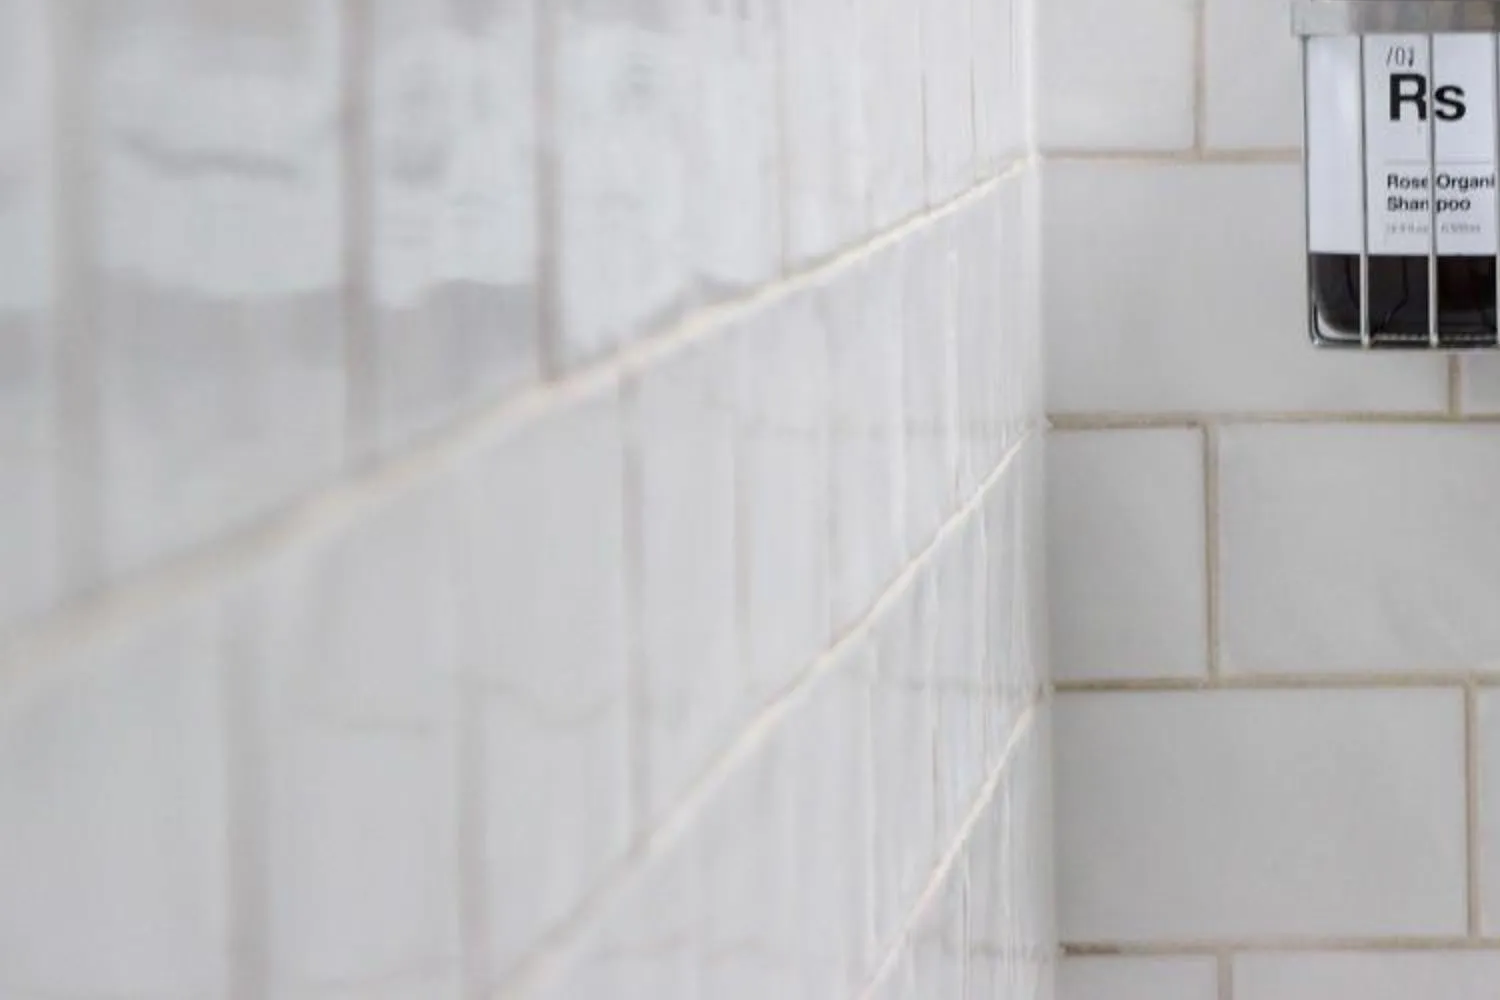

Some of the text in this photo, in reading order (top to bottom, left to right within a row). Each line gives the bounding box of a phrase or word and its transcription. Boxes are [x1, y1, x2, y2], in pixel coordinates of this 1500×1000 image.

[1389, 73, 1467, 122] Rs
[1387, 172, 1499, 193] Rose Organi
